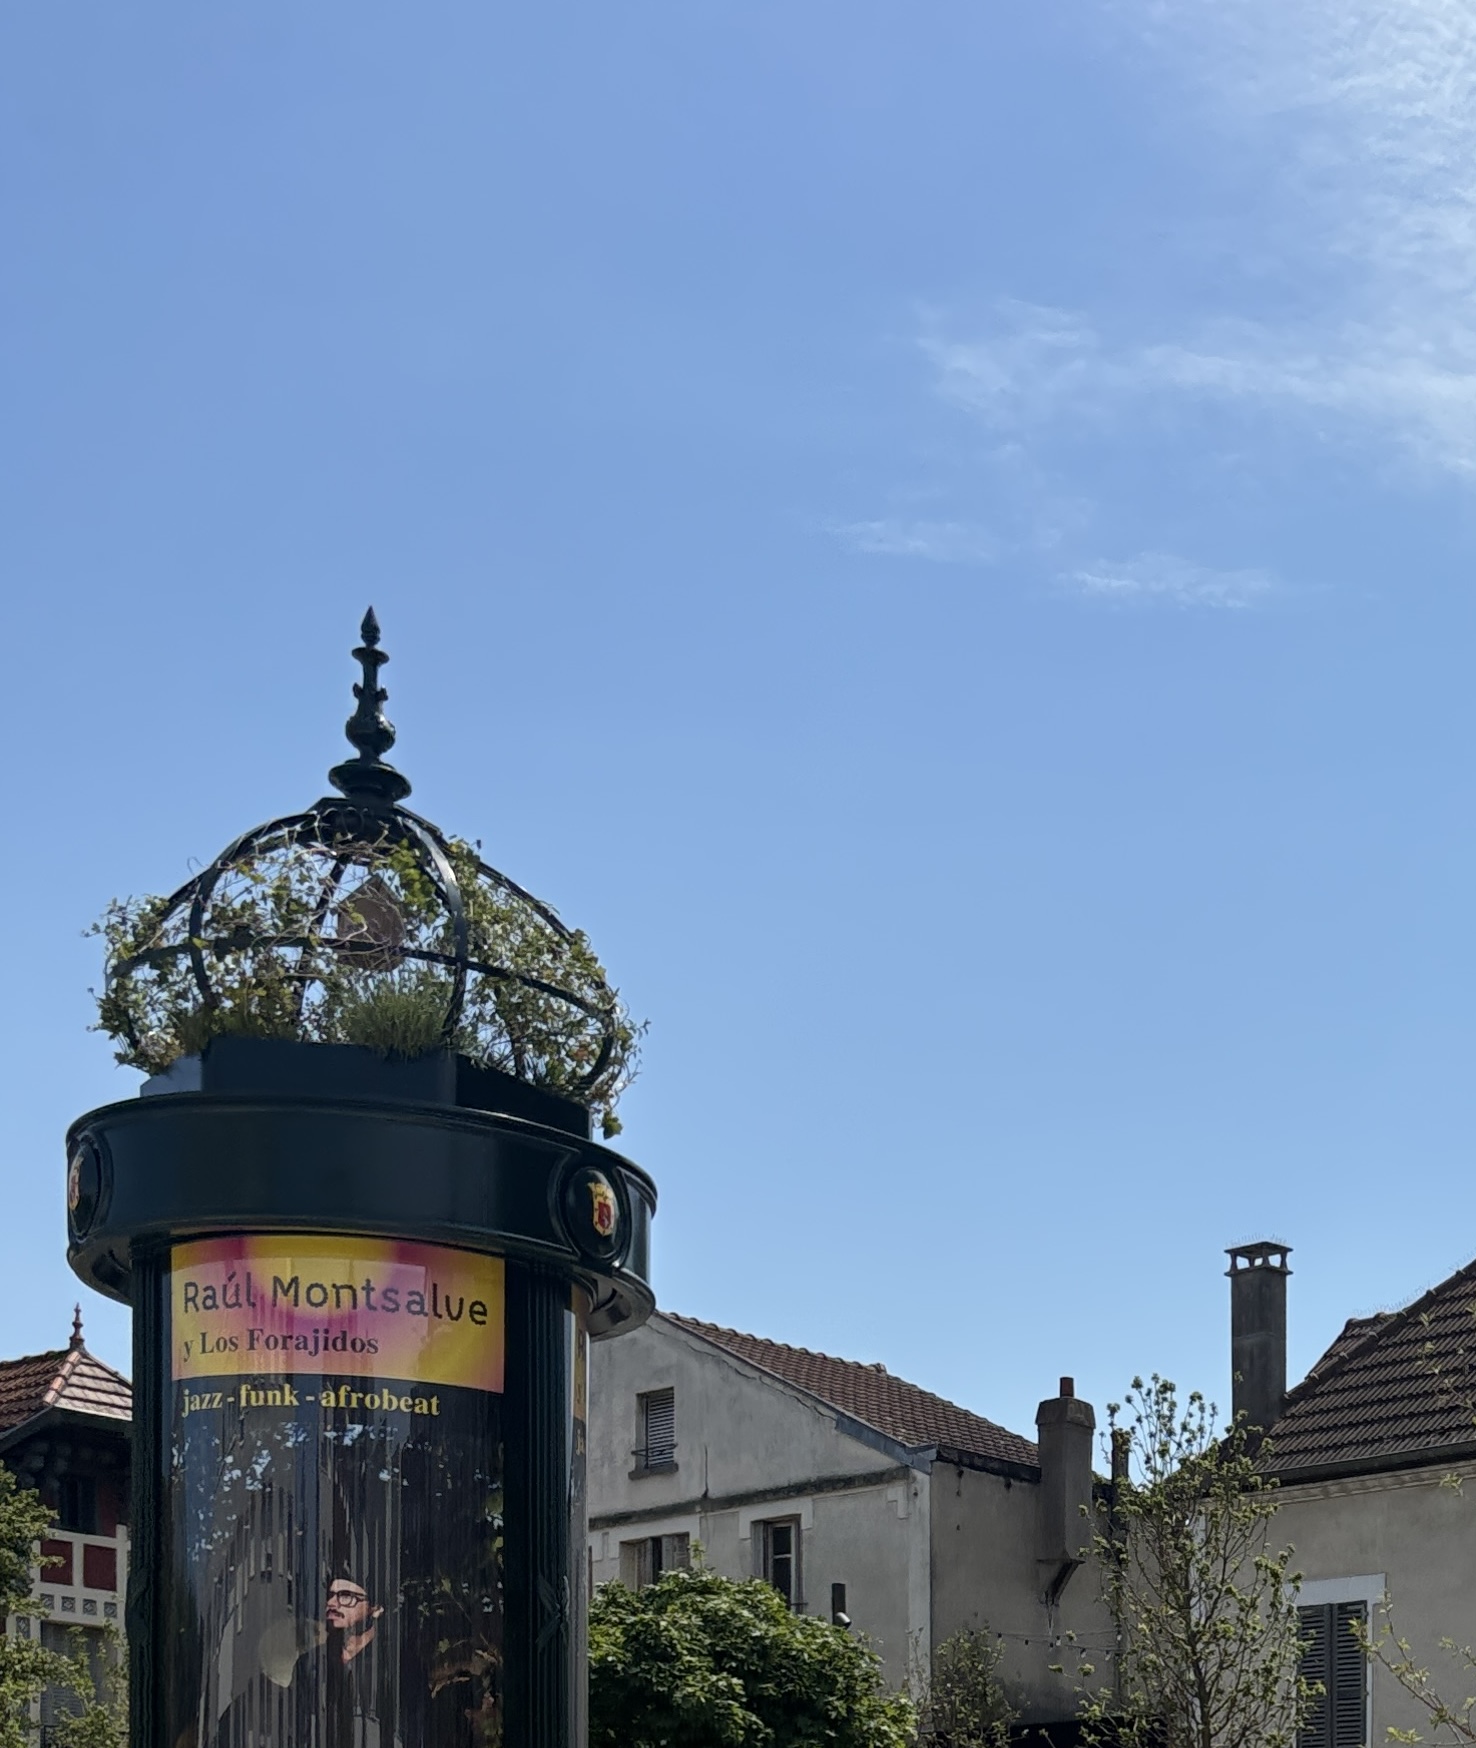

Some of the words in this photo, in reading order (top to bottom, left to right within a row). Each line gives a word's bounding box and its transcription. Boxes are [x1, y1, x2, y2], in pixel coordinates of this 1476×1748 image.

[183, 1271, 257, 1314] Raúl
[272, 1275, 488, 1326] Montsalve
[183, 1338, 195, 1363] y
[200, 1331, 239, 1354] Los
[247, 1328, 379, 1357] Forajidos
[181, 1388, 223, 1418] jazz
[239, 1383, 300, 1407] funk
[320, 1384, 441, 1416] afrobeat
